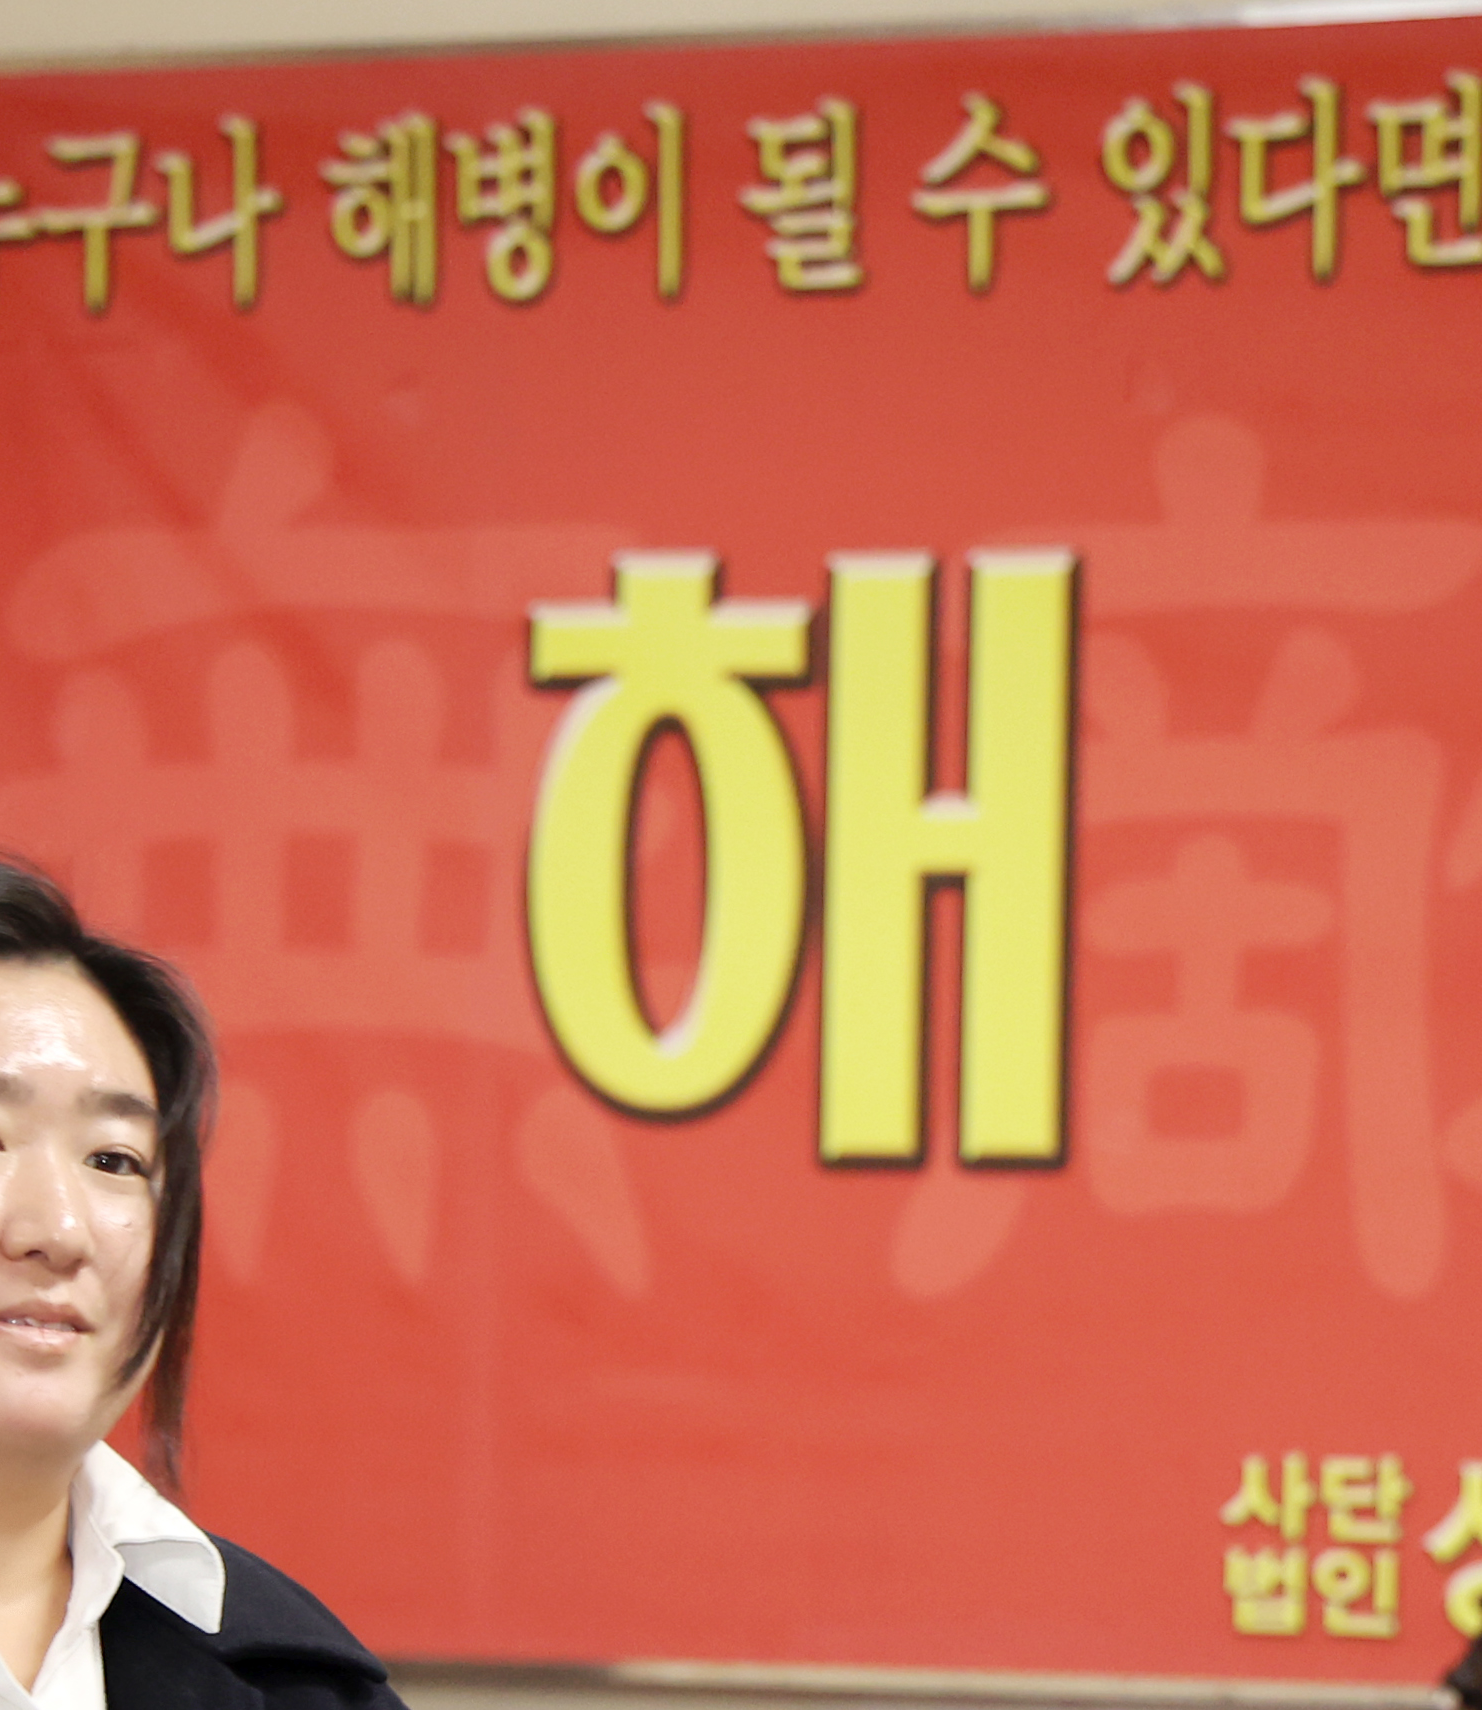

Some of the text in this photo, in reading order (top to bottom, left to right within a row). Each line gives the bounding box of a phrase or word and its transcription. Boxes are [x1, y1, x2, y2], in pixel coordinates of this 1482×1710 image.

[322, 100, 684, 304] 해병이
[739, 95, 865, 291] 될
[910, 92, 1049, 290] 수
[525, 545, 1078, 1165] 해
[1220, 1450, 1411, 1543] 사단
[1222, 1545, 1400, 1638] 법인
